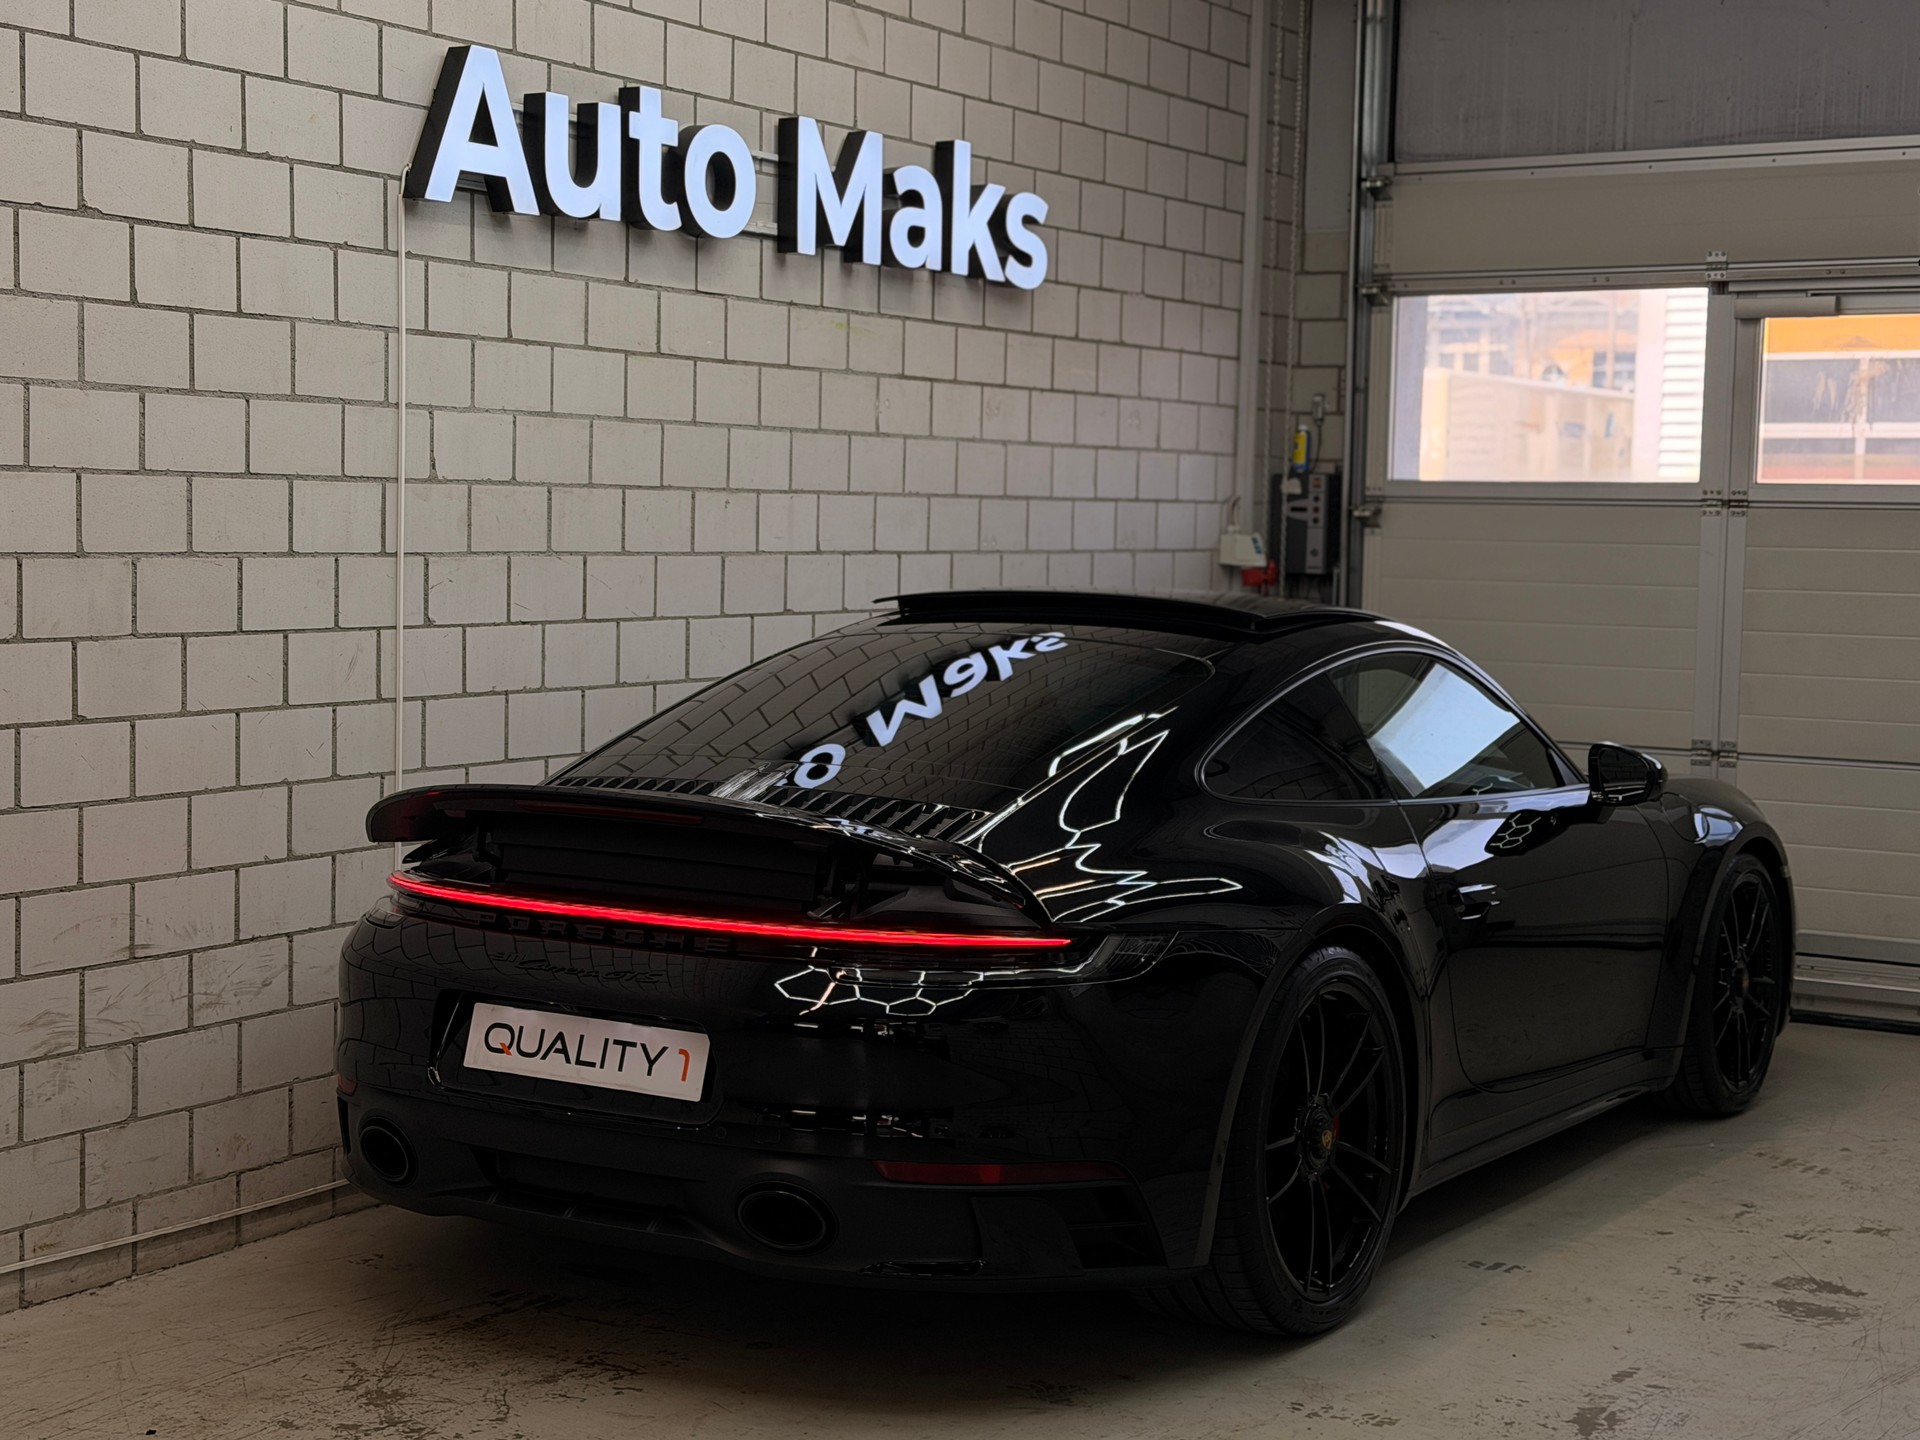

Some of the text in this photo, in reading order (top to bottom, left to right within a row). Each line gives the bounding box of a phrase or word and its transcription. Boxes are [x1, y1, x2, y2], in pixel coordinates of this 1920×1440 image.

[422, 44, 1049, 291] Auto Maks
[474, 911, 734, 953] PORSCHE
[483, 1021, 691, 1082] QUALITY 1
